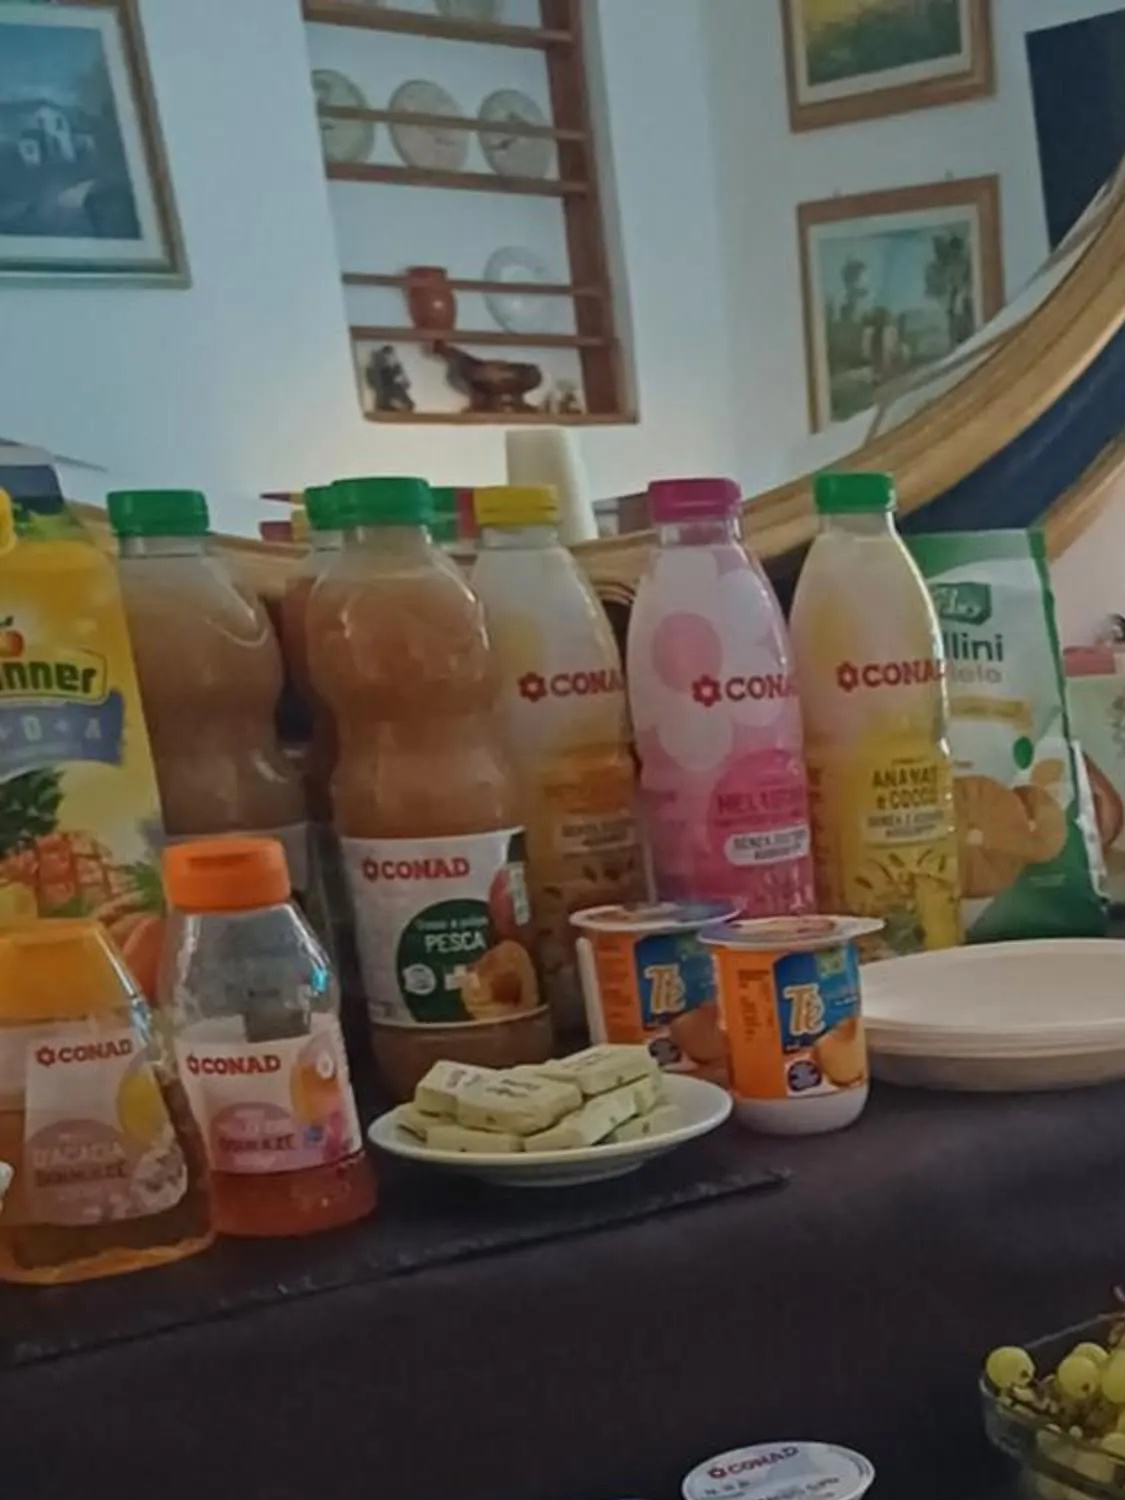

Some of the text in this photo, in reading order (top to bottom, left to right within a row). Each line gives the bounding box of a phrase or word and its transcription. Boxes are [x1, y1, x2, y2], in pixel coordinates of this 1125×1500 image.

[1, 661, 97, 694] nner
[550, 669, 624, 696] CONA
[863, 659, 944, 688] CONA
[726, 674, 799, 701] CONA
[381, 856, 470, 880] CONAD
[424, 931, 487, 953] PESCA
[58, 1038, 134, 1064] CONAD
[201, 1054, 281, 1076] CONAD
[728, 1445, 799, 1475] CONAD
